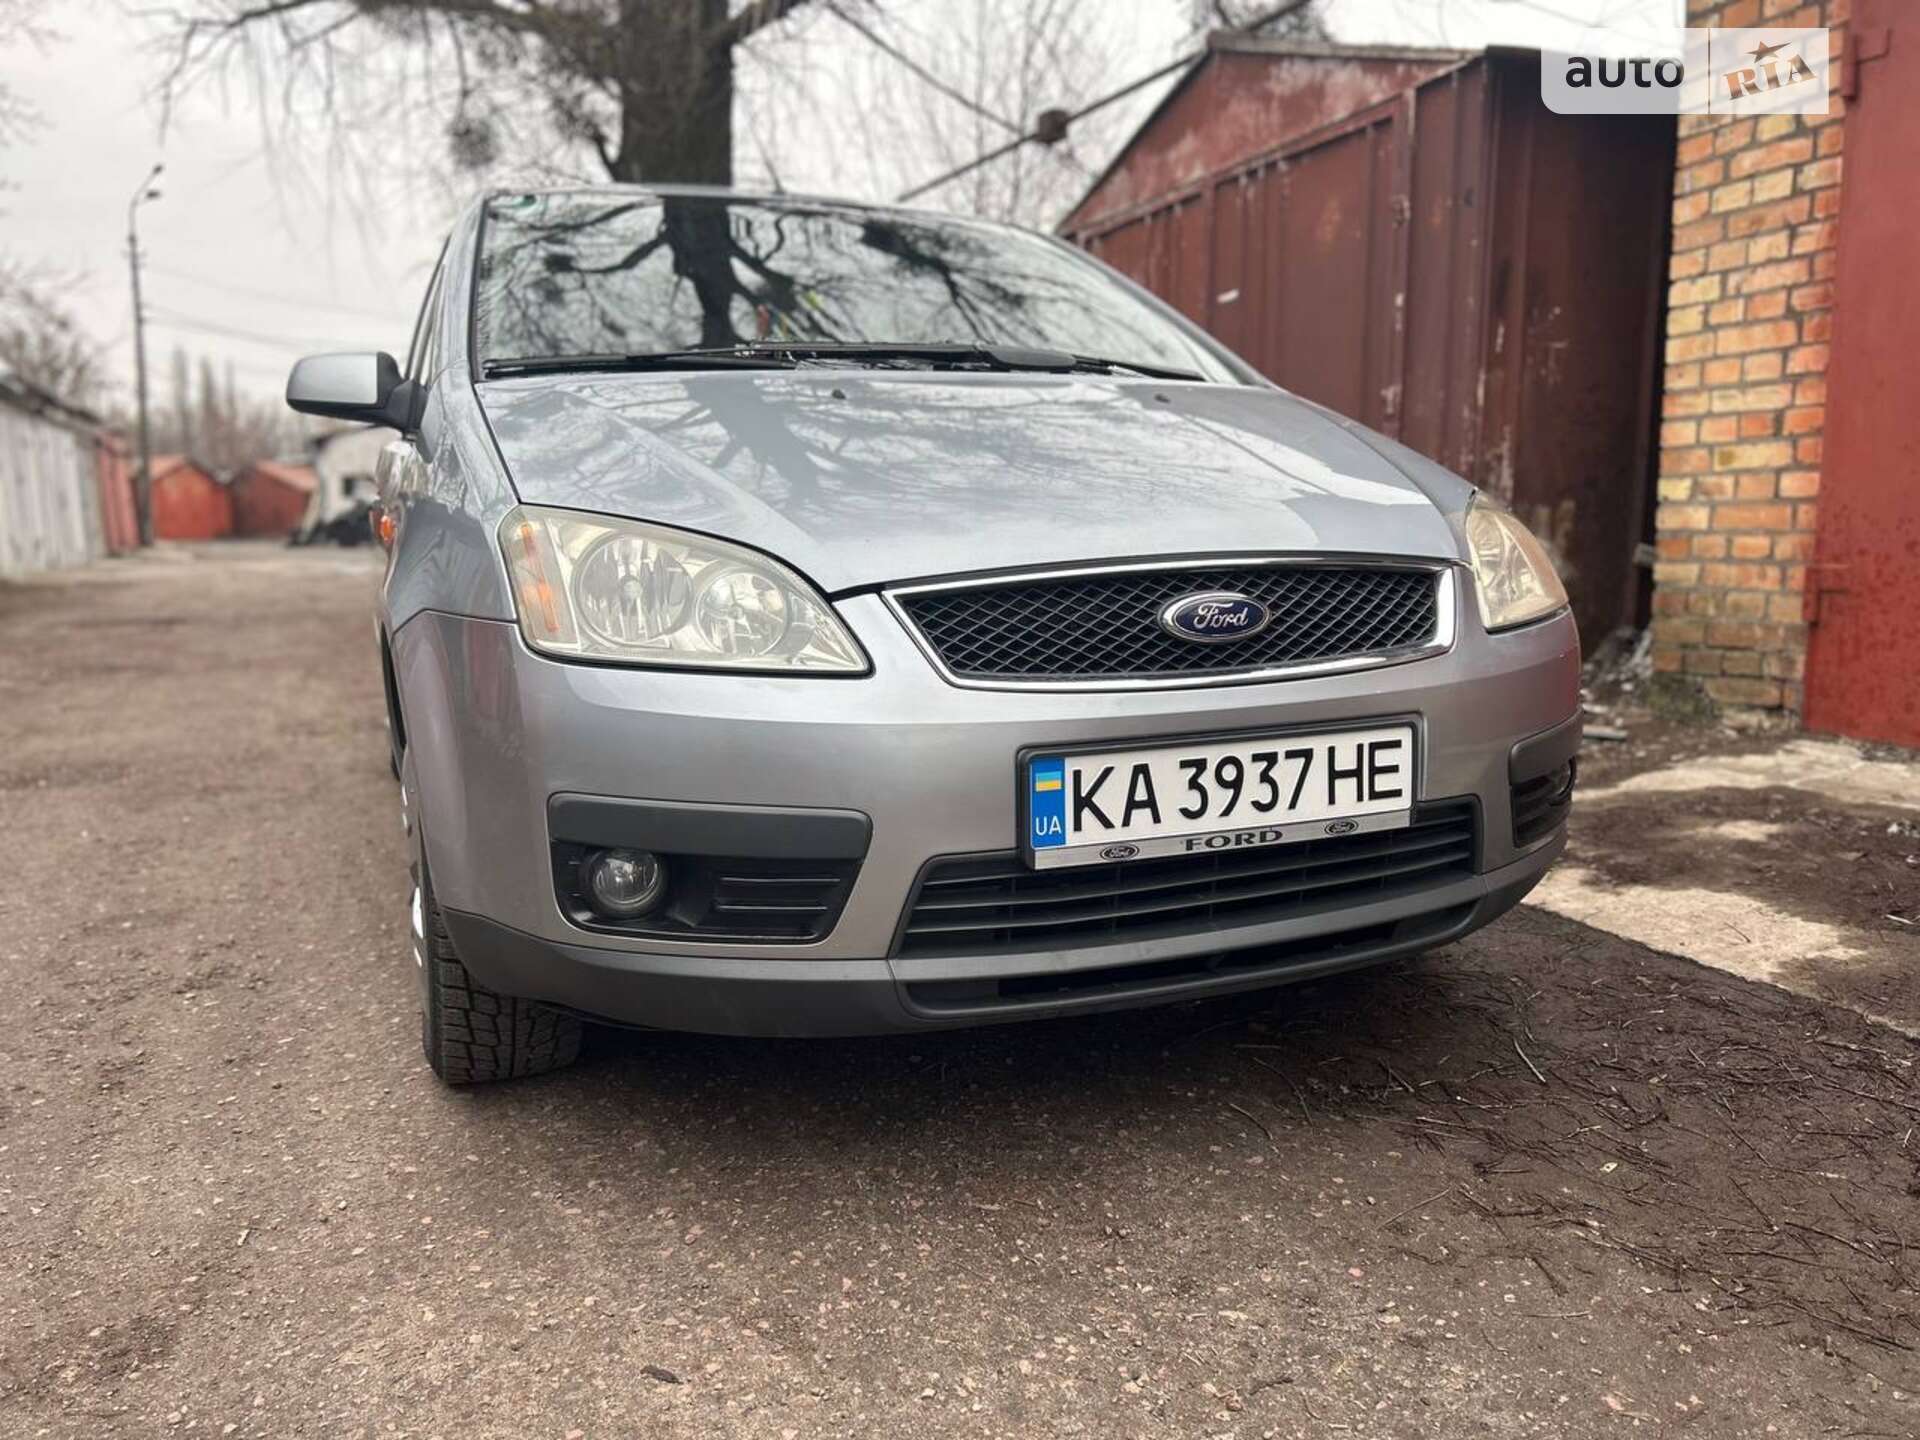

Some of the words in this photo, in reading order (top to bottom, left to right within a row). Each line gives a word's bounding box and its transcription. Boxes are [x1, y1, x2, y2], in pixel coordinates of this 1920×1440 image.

[1193, 602, 1249, 629] Ford
[1073, 763, 1162, 832] KA
[1178, 748, 1315, 821] 3937
[1327, 739, 1403, 806] HE
[1035, 815, 1062, 836] UA
[1185, 830, 1283, 851] FORD
